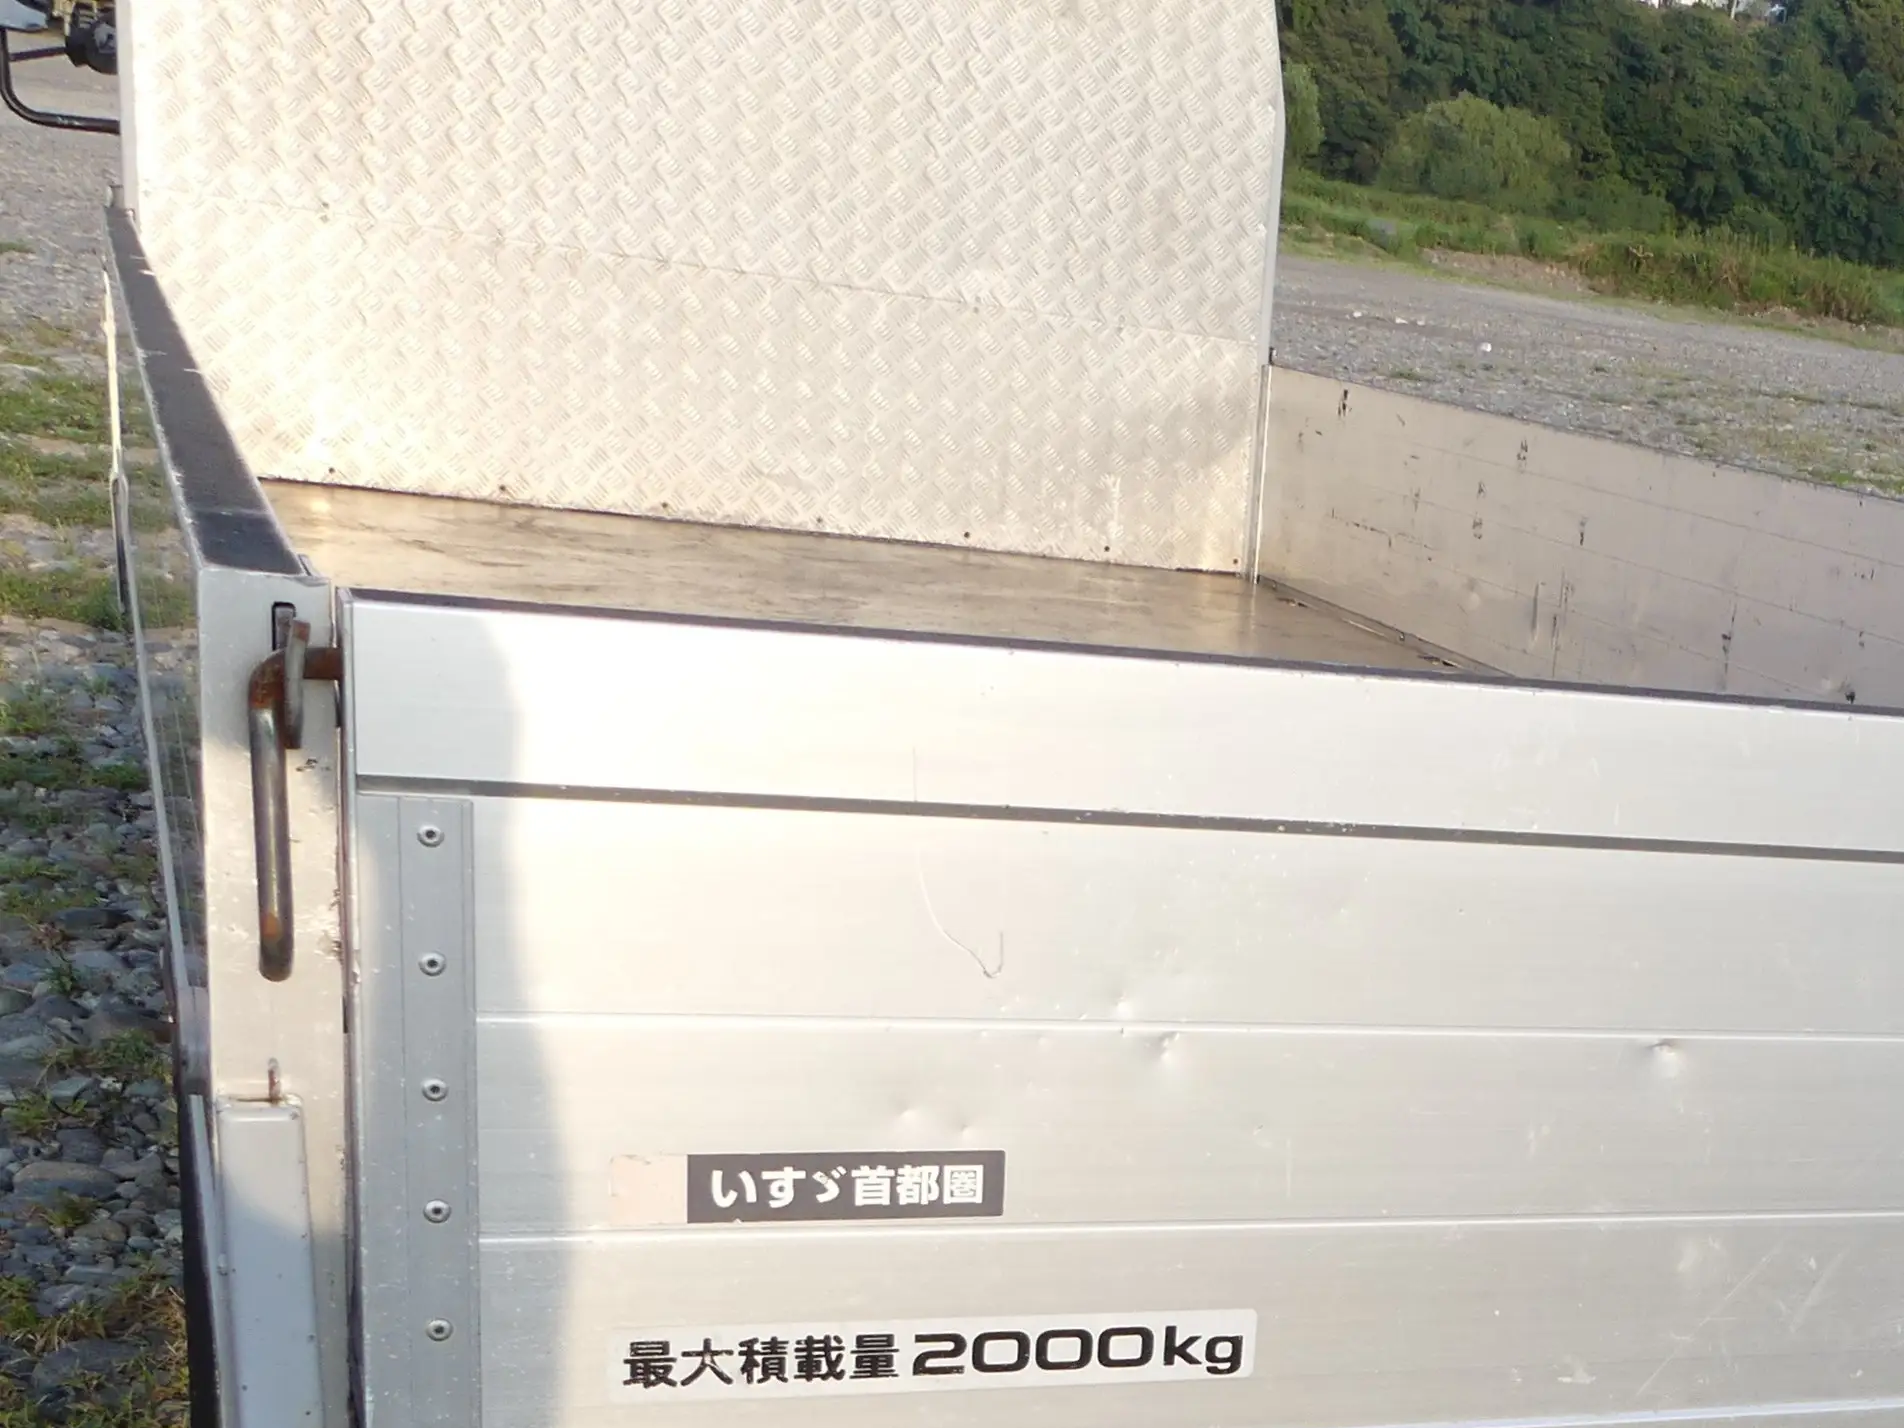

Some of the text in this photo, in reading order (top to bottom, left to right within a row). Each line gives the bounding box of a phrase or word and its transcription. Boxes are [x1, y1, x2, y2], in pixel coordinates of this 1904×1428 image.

[710, 1163, 985, 1208] いすゞ首都圏
